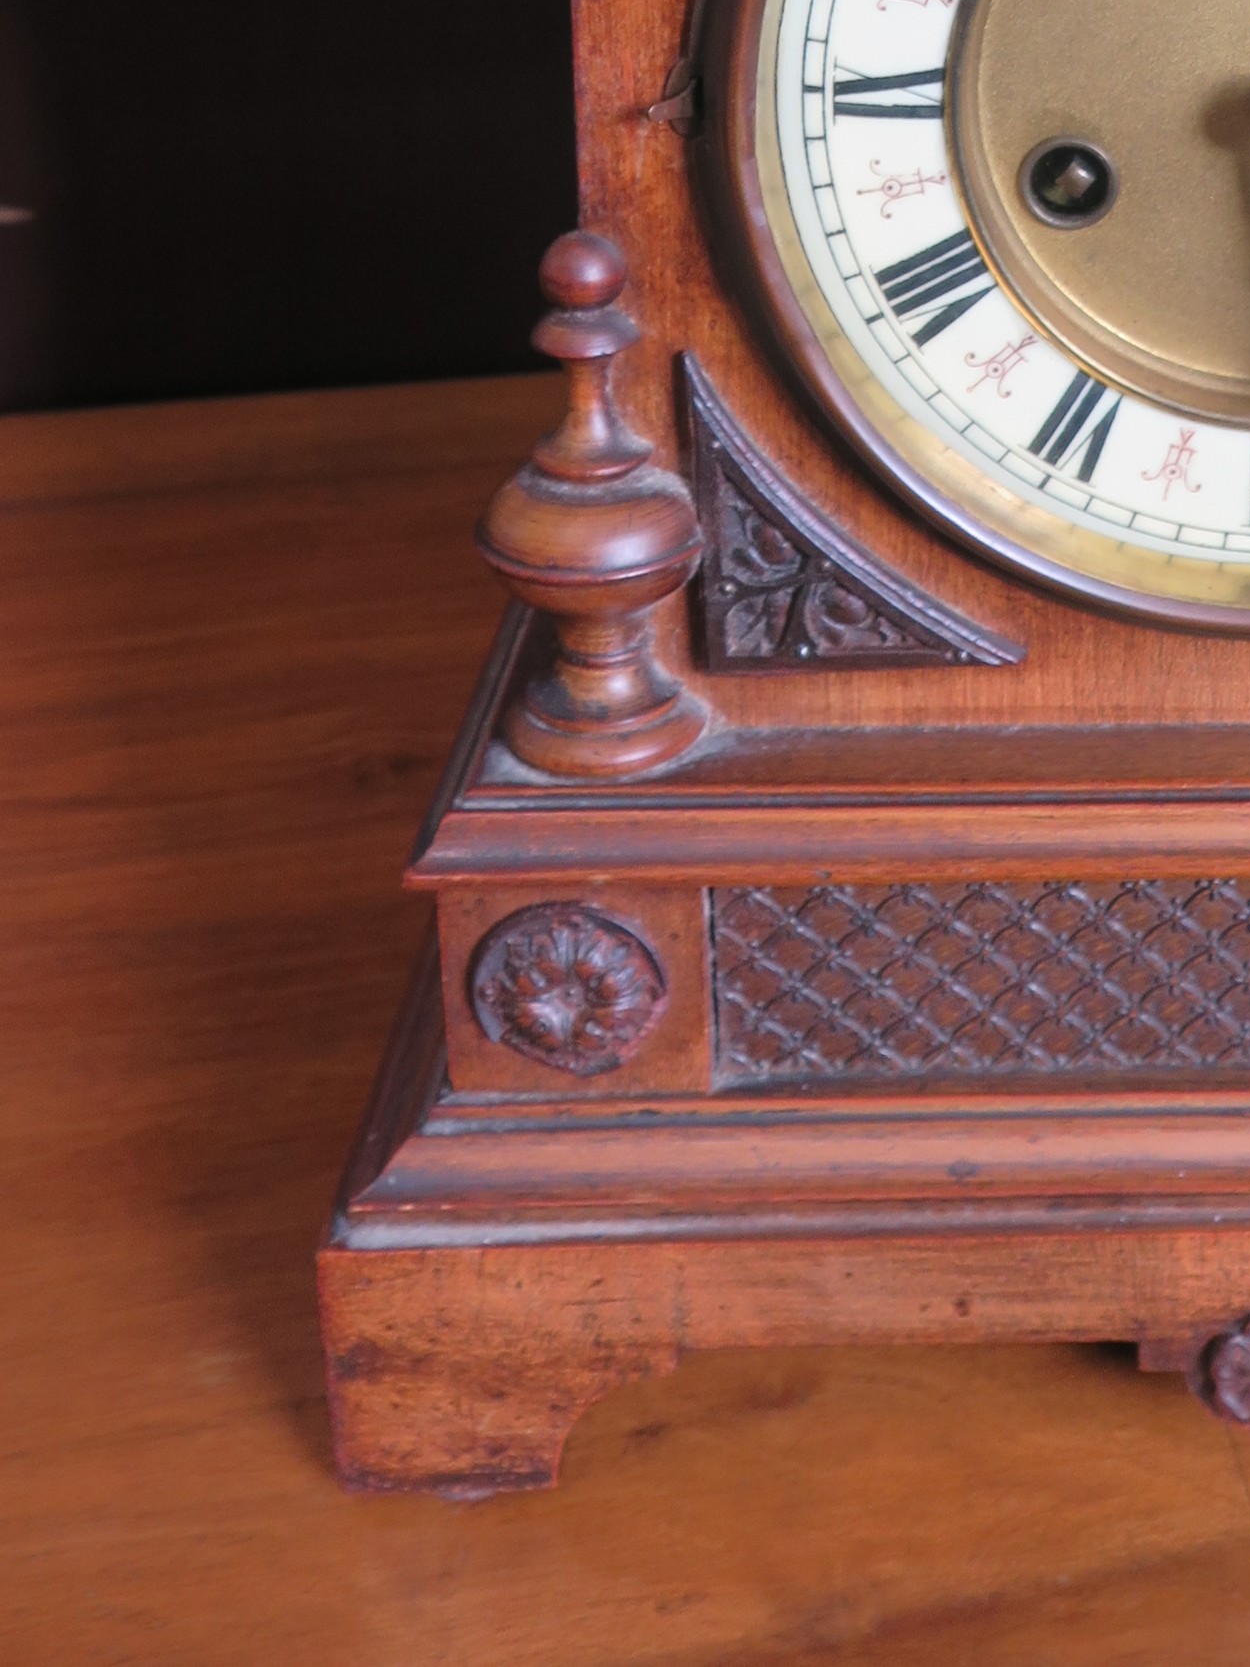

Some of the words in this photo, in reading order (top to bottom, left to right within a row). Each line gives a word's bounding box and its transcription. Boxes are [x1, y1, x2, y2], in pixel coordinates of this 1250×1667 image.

[832, 56, 945, 126] IX
[869, 228, 999, 354] VIII
[1018, 371, 1124, 484] VII
